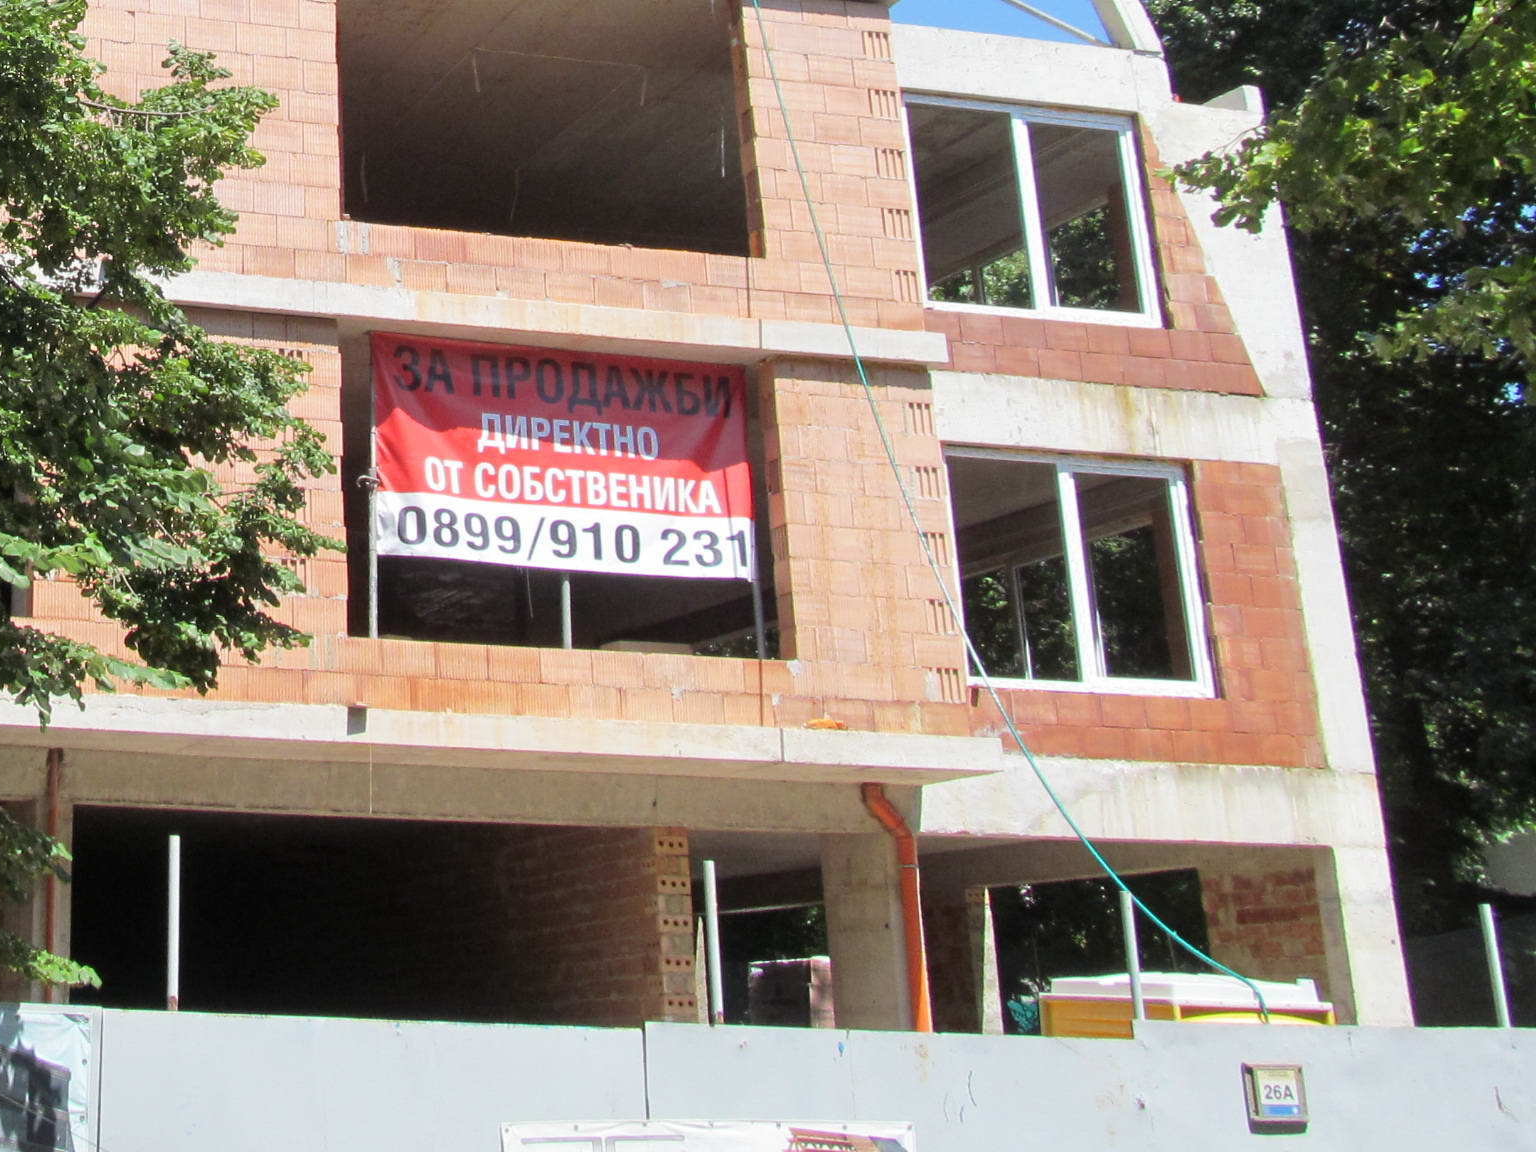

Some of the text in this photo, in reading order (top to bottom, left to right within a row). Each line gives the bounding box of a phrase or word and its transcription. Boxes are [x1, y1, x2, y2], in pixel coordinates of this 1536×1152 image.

[394, 345, 733, 419] ЗА ПРОДАЖБИ
[477, 412, 660, 460] ДИРЕКТНО
[424, 456, 722, 514] ОТ СОБСТВЕНИКА
[397, 505, 749, 568] 0899/910 231
